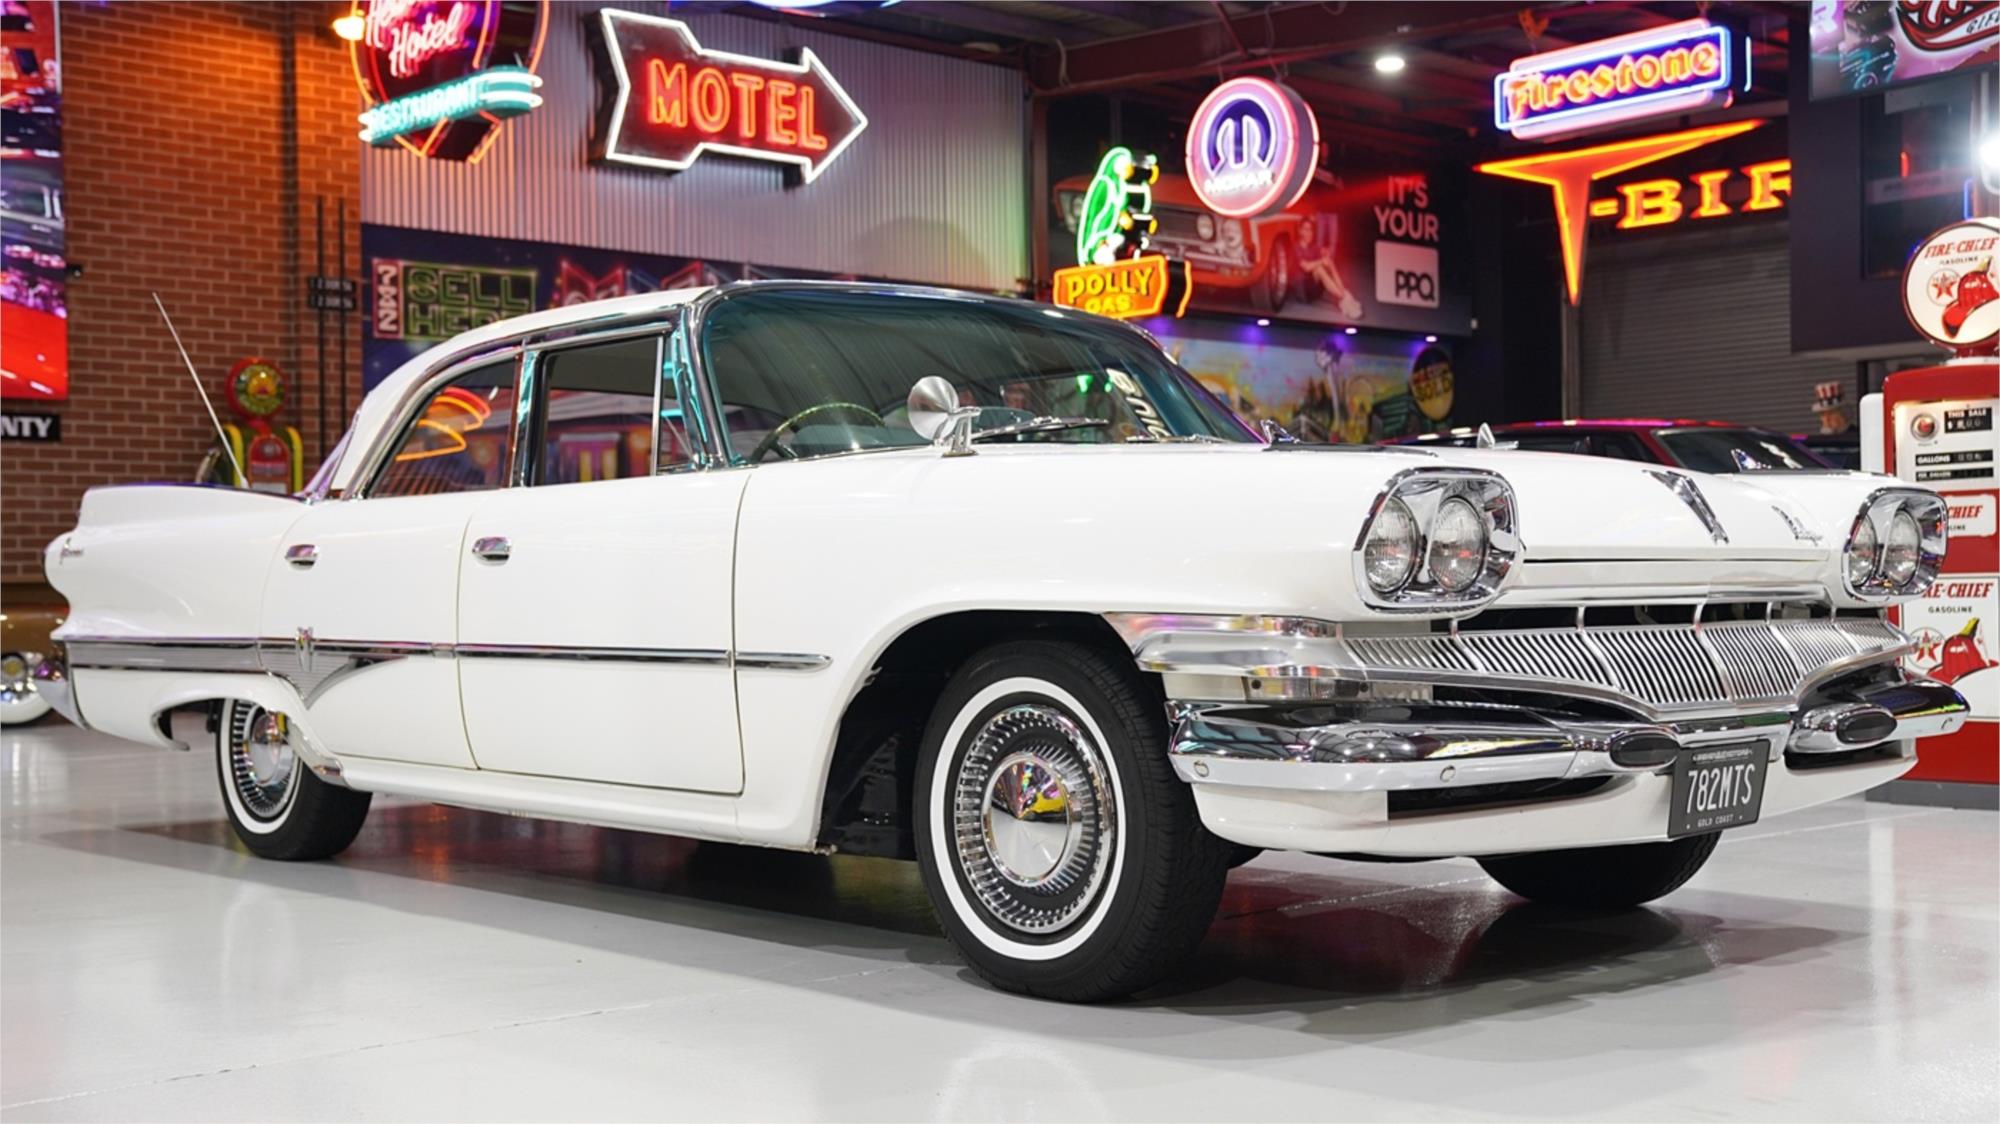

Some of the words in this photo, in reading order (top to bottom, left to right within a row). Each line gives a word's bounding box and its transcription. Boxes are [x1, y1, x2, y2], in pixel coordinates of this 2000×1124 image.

[388, 2, 464, 77] Hotel
[1506, 41, 1720, 121] Firestone
[368, 75, 483, 134] RESTAURANT
[648, 57, 828, 150] MOTEL
[1204, 171, 1275, 195] MOPAR
[1386, 176, 1429, 208] IT'S
[1374, 205, 1439, 241] YOUR
[408, 268, 531, 311] SELL
[1066, 267, 1153, 304] POLLY
[1395, 270, 1435, 301] PPQ
[408, 303, 527, 336] HER
[1084, 296, 1133, 314] GAS
[0, 415, 53, 438] NTY
[1968, 408, 1987, 417] SALE
[1917, 454, 1951, 464] GALLONS
[1928, 606, 1973, 614] GASOLINE
[1687, 763, 1756, 814] 782MTS
